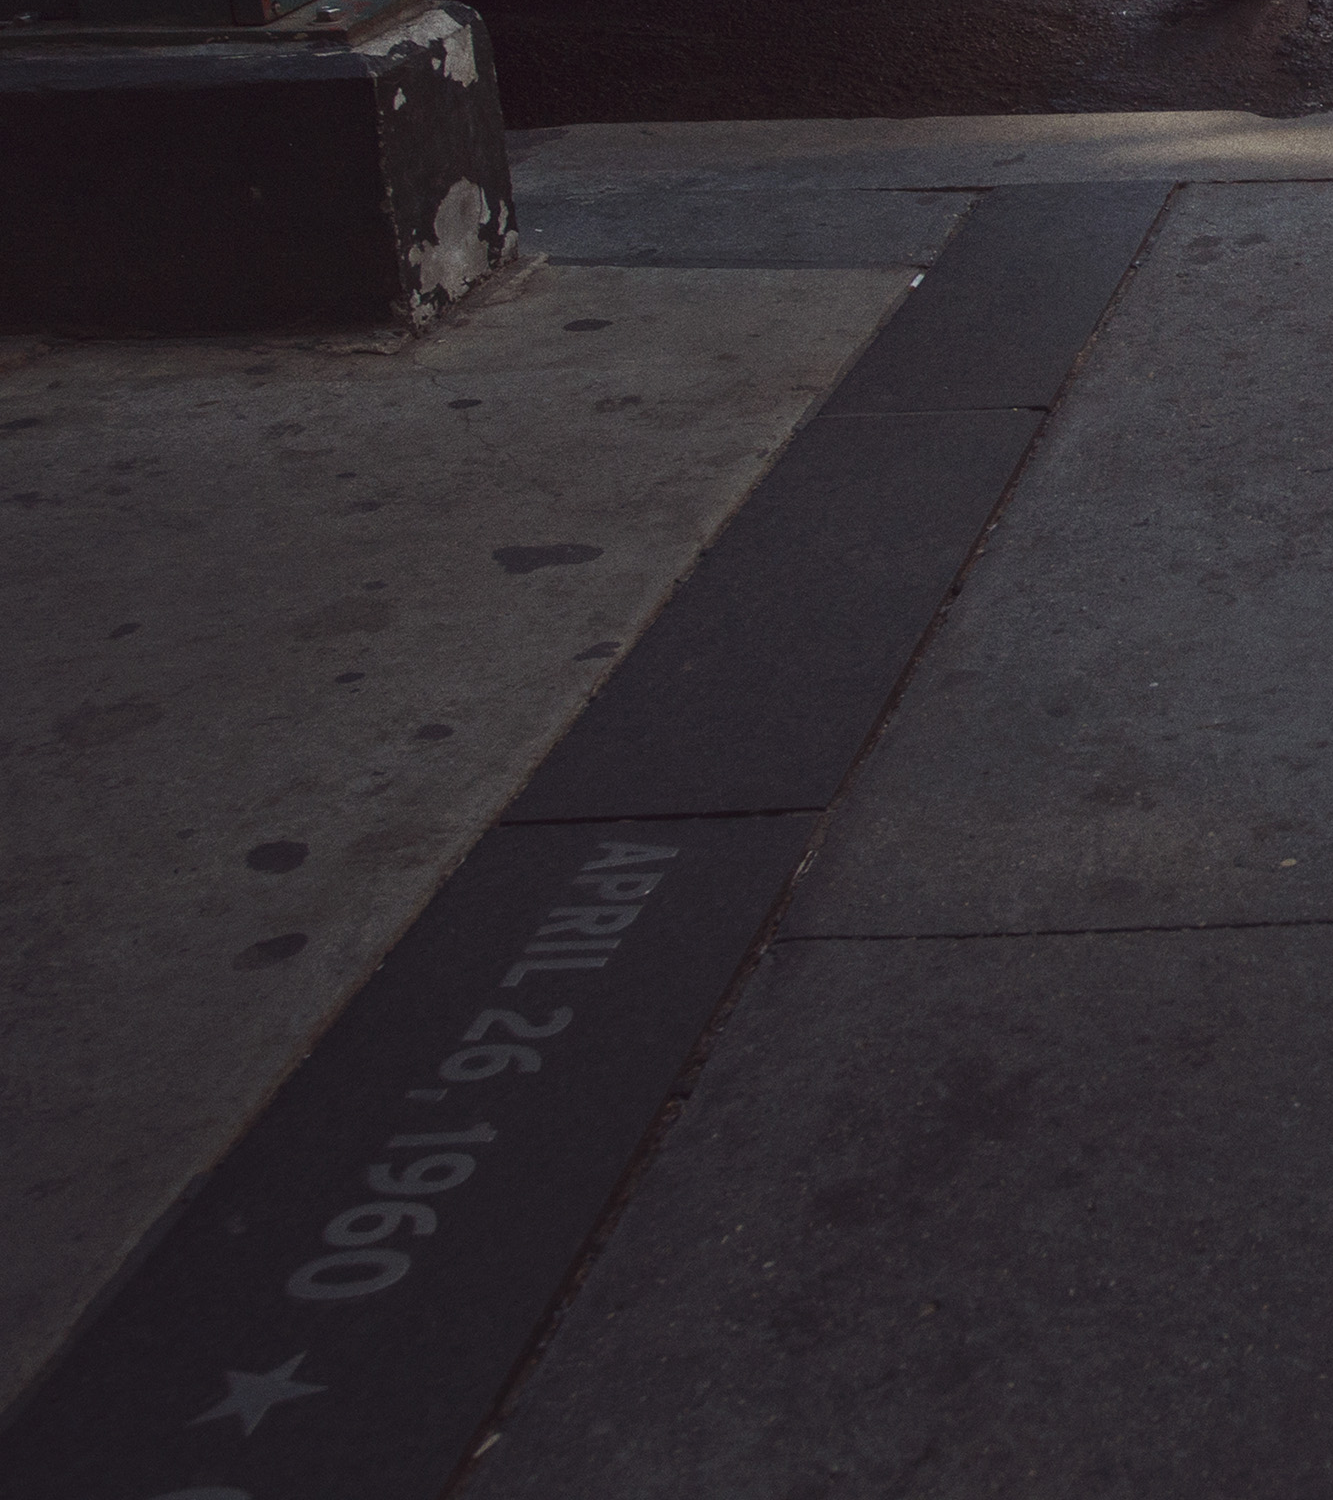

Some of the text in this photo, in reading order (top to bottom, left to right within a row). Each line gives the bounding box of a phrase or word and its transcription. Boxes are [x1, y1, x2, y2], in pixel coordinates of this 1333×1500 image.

[286, 838, 681, 1301] APRIL 26, 1960
